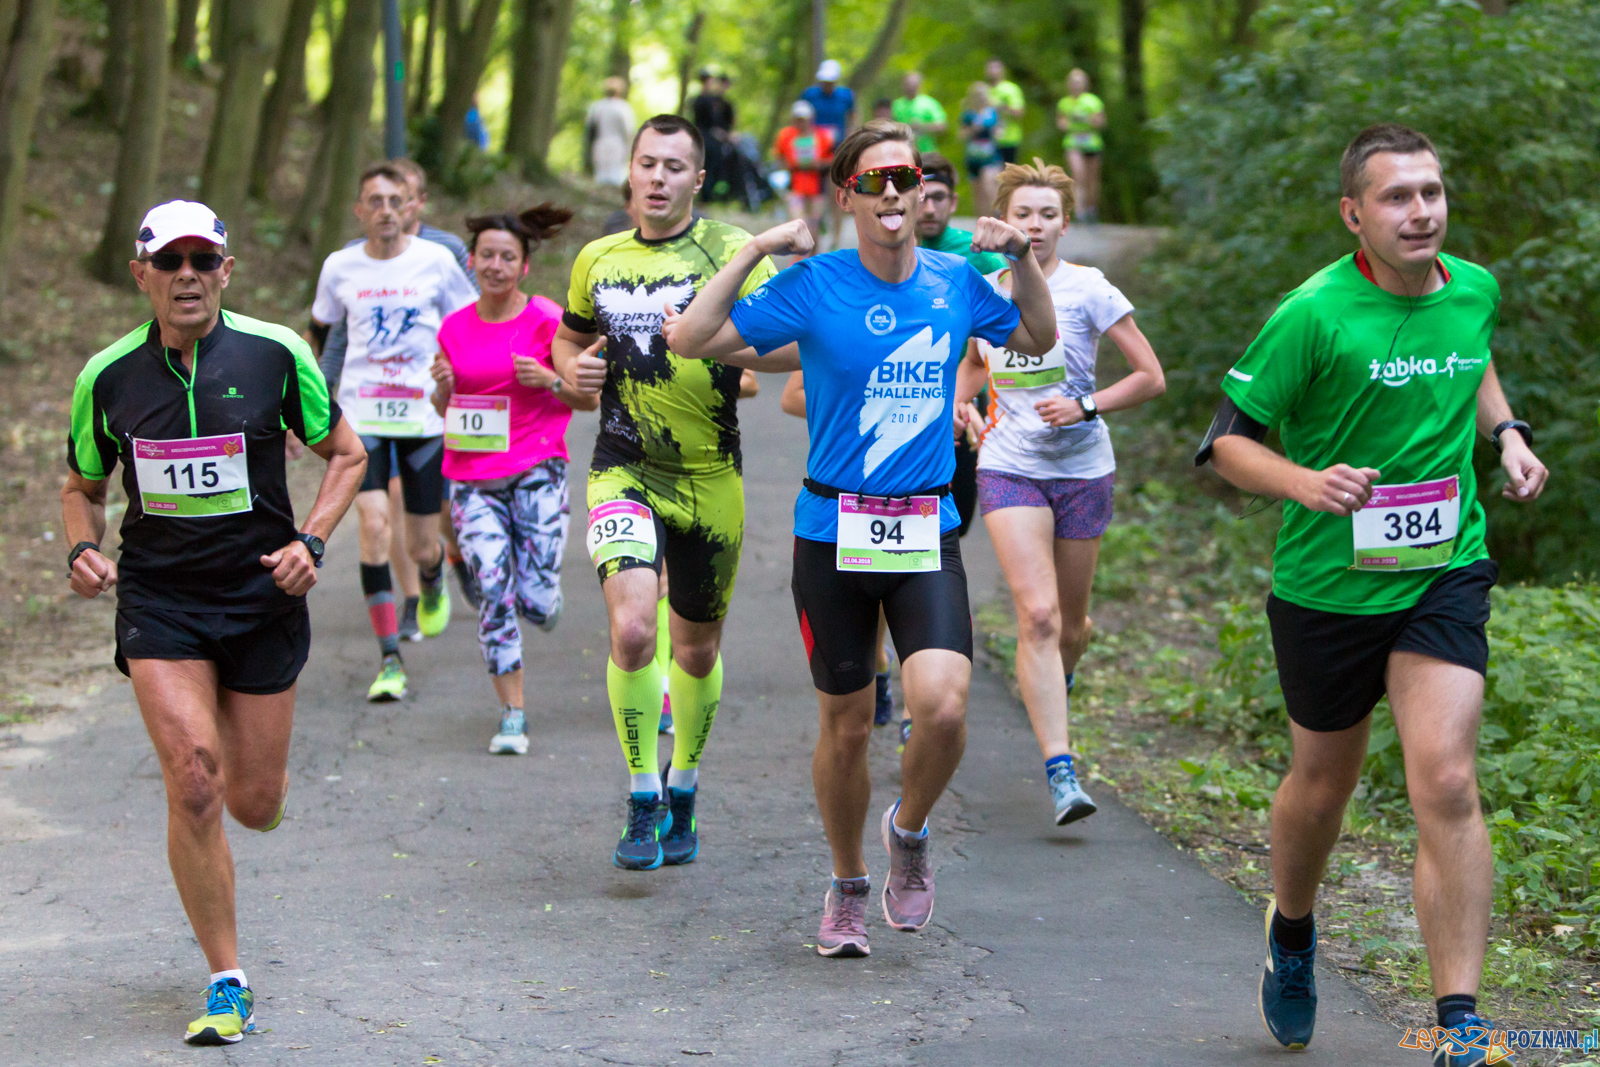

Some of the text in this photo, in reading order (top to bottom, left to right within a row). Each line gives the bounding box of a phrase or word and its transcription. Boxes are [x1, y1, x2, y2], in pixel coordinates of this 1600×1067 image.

[622, 312, 661, 322] DIRTY
[608, 325, 663, 335] SPARRO
[877, 361, 941, 383] BIKE
[1369, 356, 1437, 379] żabka
[863, 386, 947, 399] CHALLENGE
[374, 401, 409, 417] 152
[891, 413, 918, 424] 2016
[459, 412, 483, 431] 10
[163, 461, 219, 490] 115
[593, 517, 634, 545] 392
[870, 519, 905, 545] 94
[1384, 507, 1442, 541] 384
